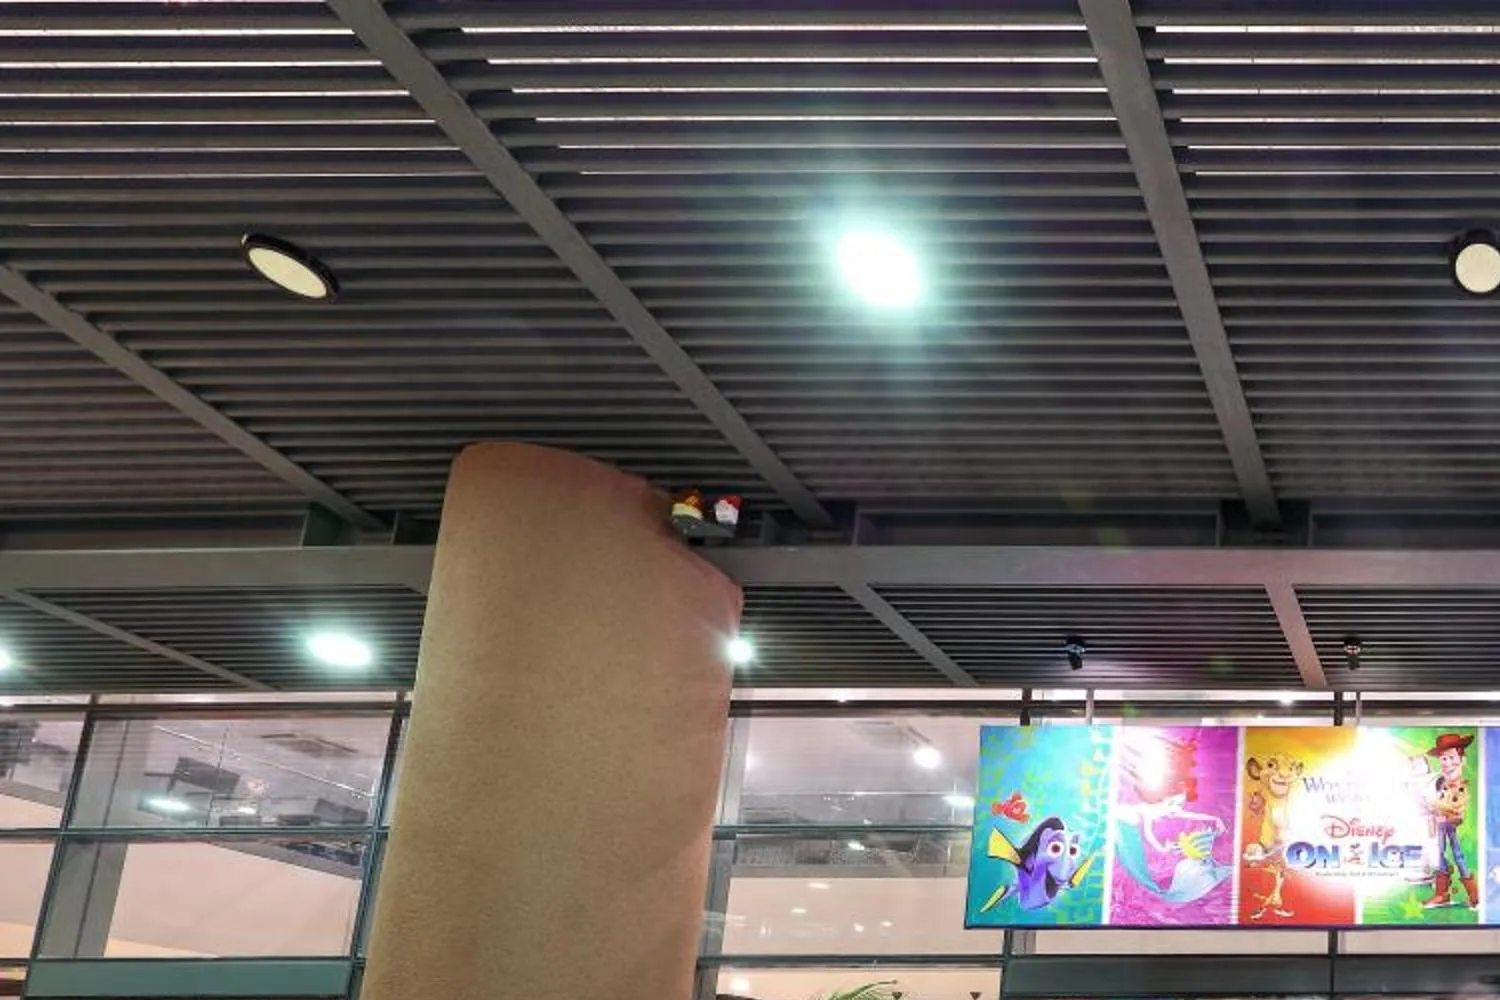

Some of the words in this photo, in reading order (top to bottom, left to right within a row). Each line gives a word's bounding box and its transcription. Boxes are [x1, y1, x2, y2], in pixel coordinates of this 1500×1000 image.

[1320, 814, 1395, 844] Disney
[1286, 841, 1341, 868] ON
[1367, 841, 1423, 869] ICE
